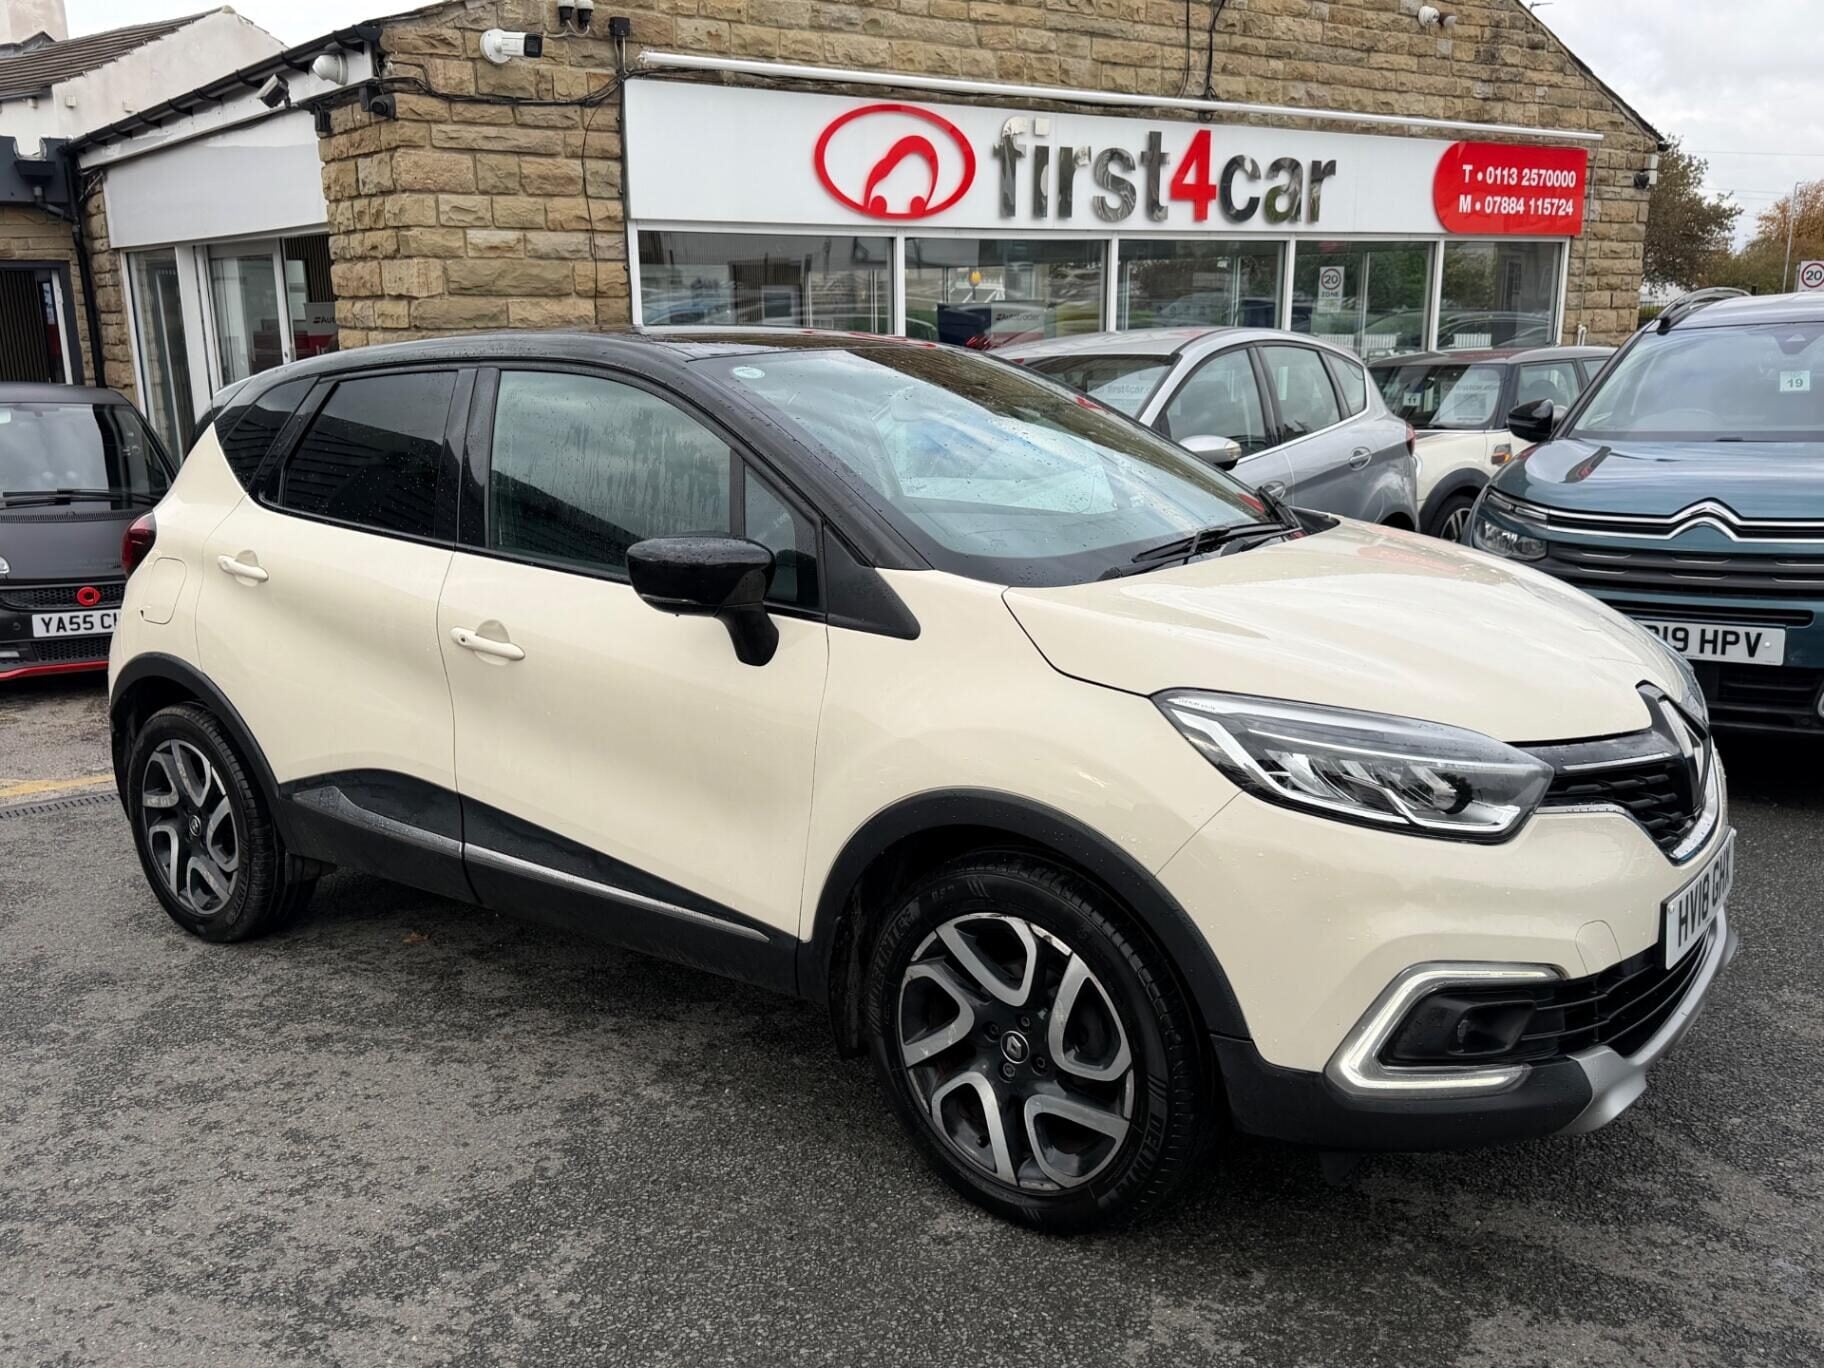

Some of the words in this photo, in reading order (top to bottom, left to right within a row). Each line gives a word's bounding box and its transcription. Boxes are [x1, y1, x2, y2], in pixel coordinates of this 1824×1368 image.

[992, 117, 1337, 222] first4car
[1462, 164, 1473, 183] T
[1486, 167, 1518, 185] 0113
[1521, 169, 1577, 187] 2570000
[1458, 194, 1472, 213] M
[1484, 196, 1525, 214] 07884
[1529, 197, 1574, 216] 115724
[1325, 274, 1339, 285] 20
[1805, 270, 1823, 281] 20
[1786, 378, 1803, 388] 19
[40, 614, 94, 633] YA55
[1699, 628, 1762, 658] HPV
[1678, 873, 1710, 948] HV18
[1712, 842, 1731, 907] GHX
